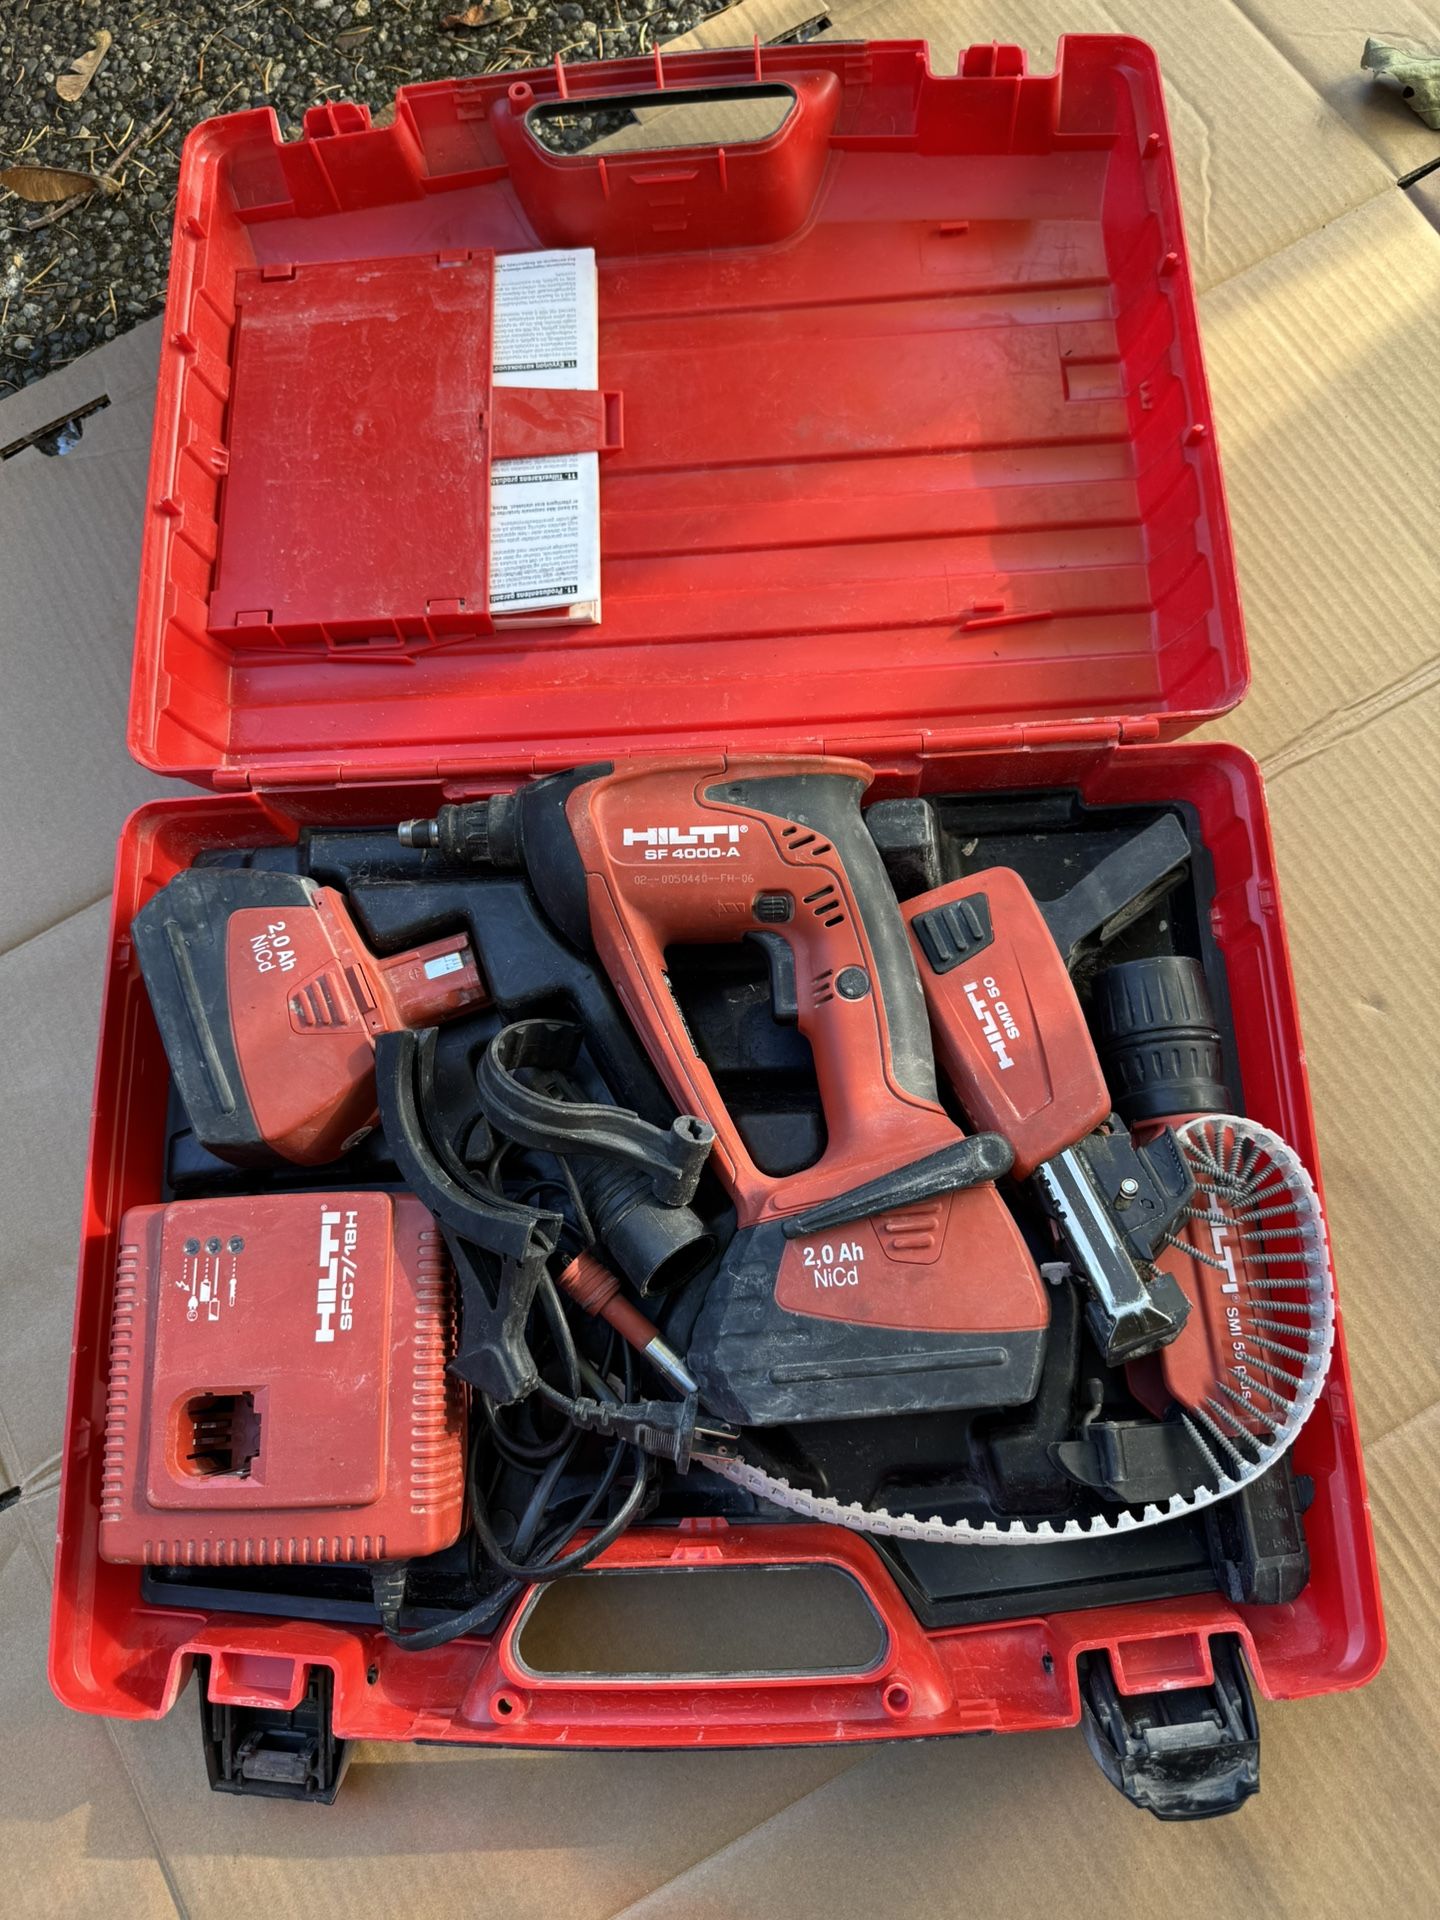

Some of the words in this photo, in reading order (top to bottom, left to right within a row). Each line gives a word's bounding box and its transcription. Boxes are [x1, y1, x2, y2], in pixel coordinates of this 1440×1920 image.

[516, 587, 563, 599] Produsentens
[645, 849, 668, 860] SF
[672, 847, 740, 859] 4000-A
[268, 921, 291, 948] 2,0
[250, 934, 276, 973] NiCd
[276, 950, 297, 971] Ah
[983, 976, 1001, 998] 50
[994, 1001, 1020, 1040] SMD
[803, 1244, 834, 1269] 2,0
[839, 1242, 864, 1262] Ah
[340, 1211, 358, 1331] SFC7/18H
[814, 1266, 858, 1289] NiCd
[1226, 1307, 1243, 1336] SMI
